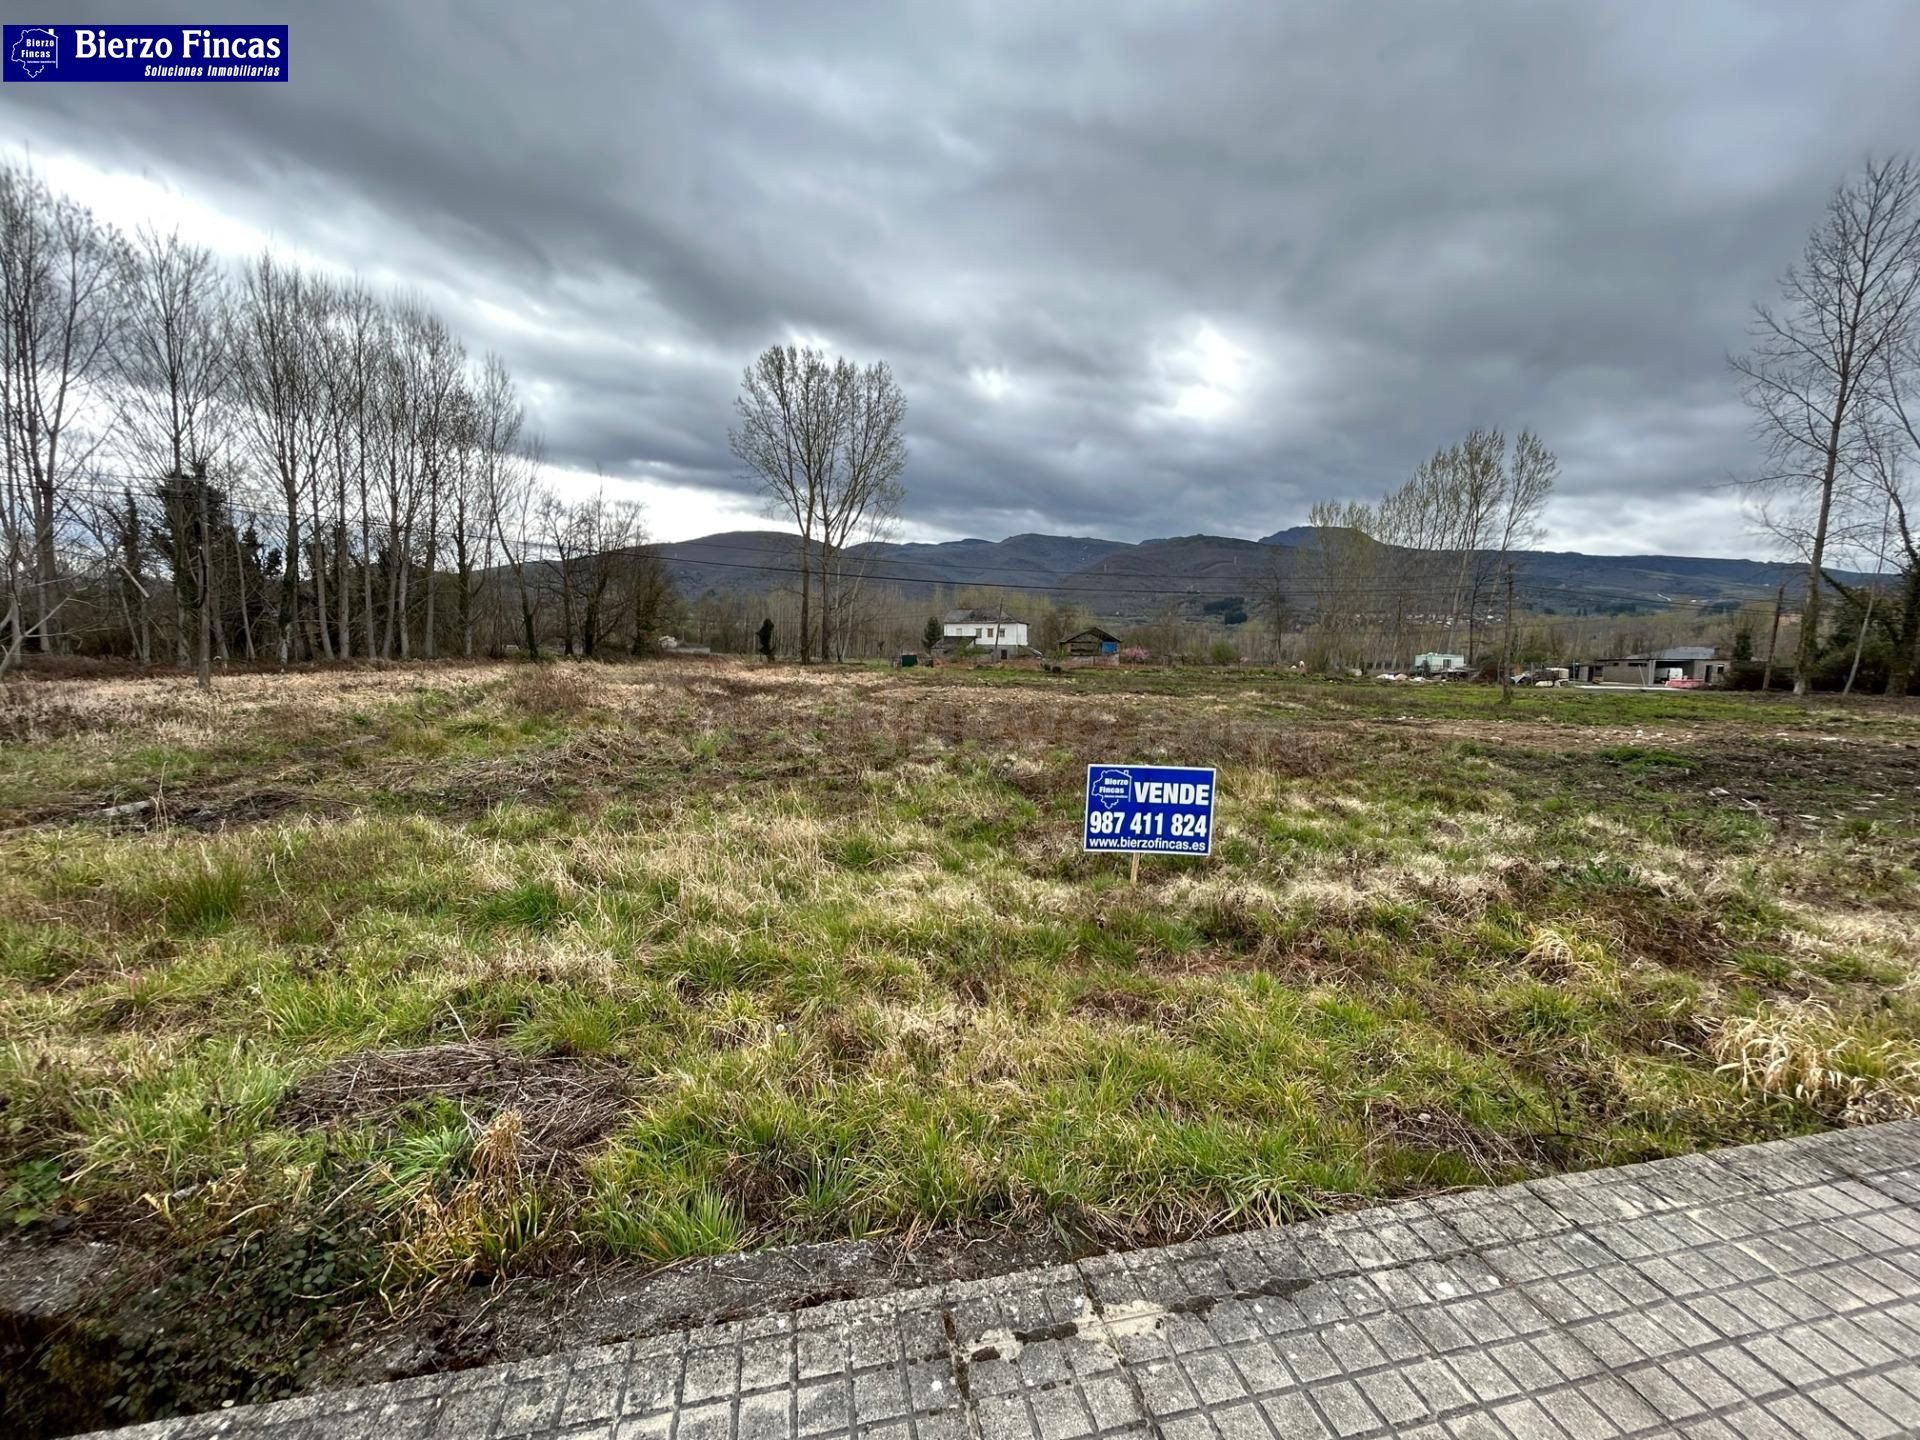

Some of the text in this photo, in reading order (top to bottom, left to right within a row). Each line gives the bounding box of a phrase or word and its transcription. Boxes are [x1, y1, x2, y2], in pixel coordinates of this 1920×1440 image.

[1104, 778, 1129, 786] Bierzo
[1099, 786, 1125, 794] Fincas
[1134, 781, 1210, 806] VENDE
[1089, 810, 1207, 837] 987 411 824
[1089, 836, 1206, 851] www.bierzofincas.es
